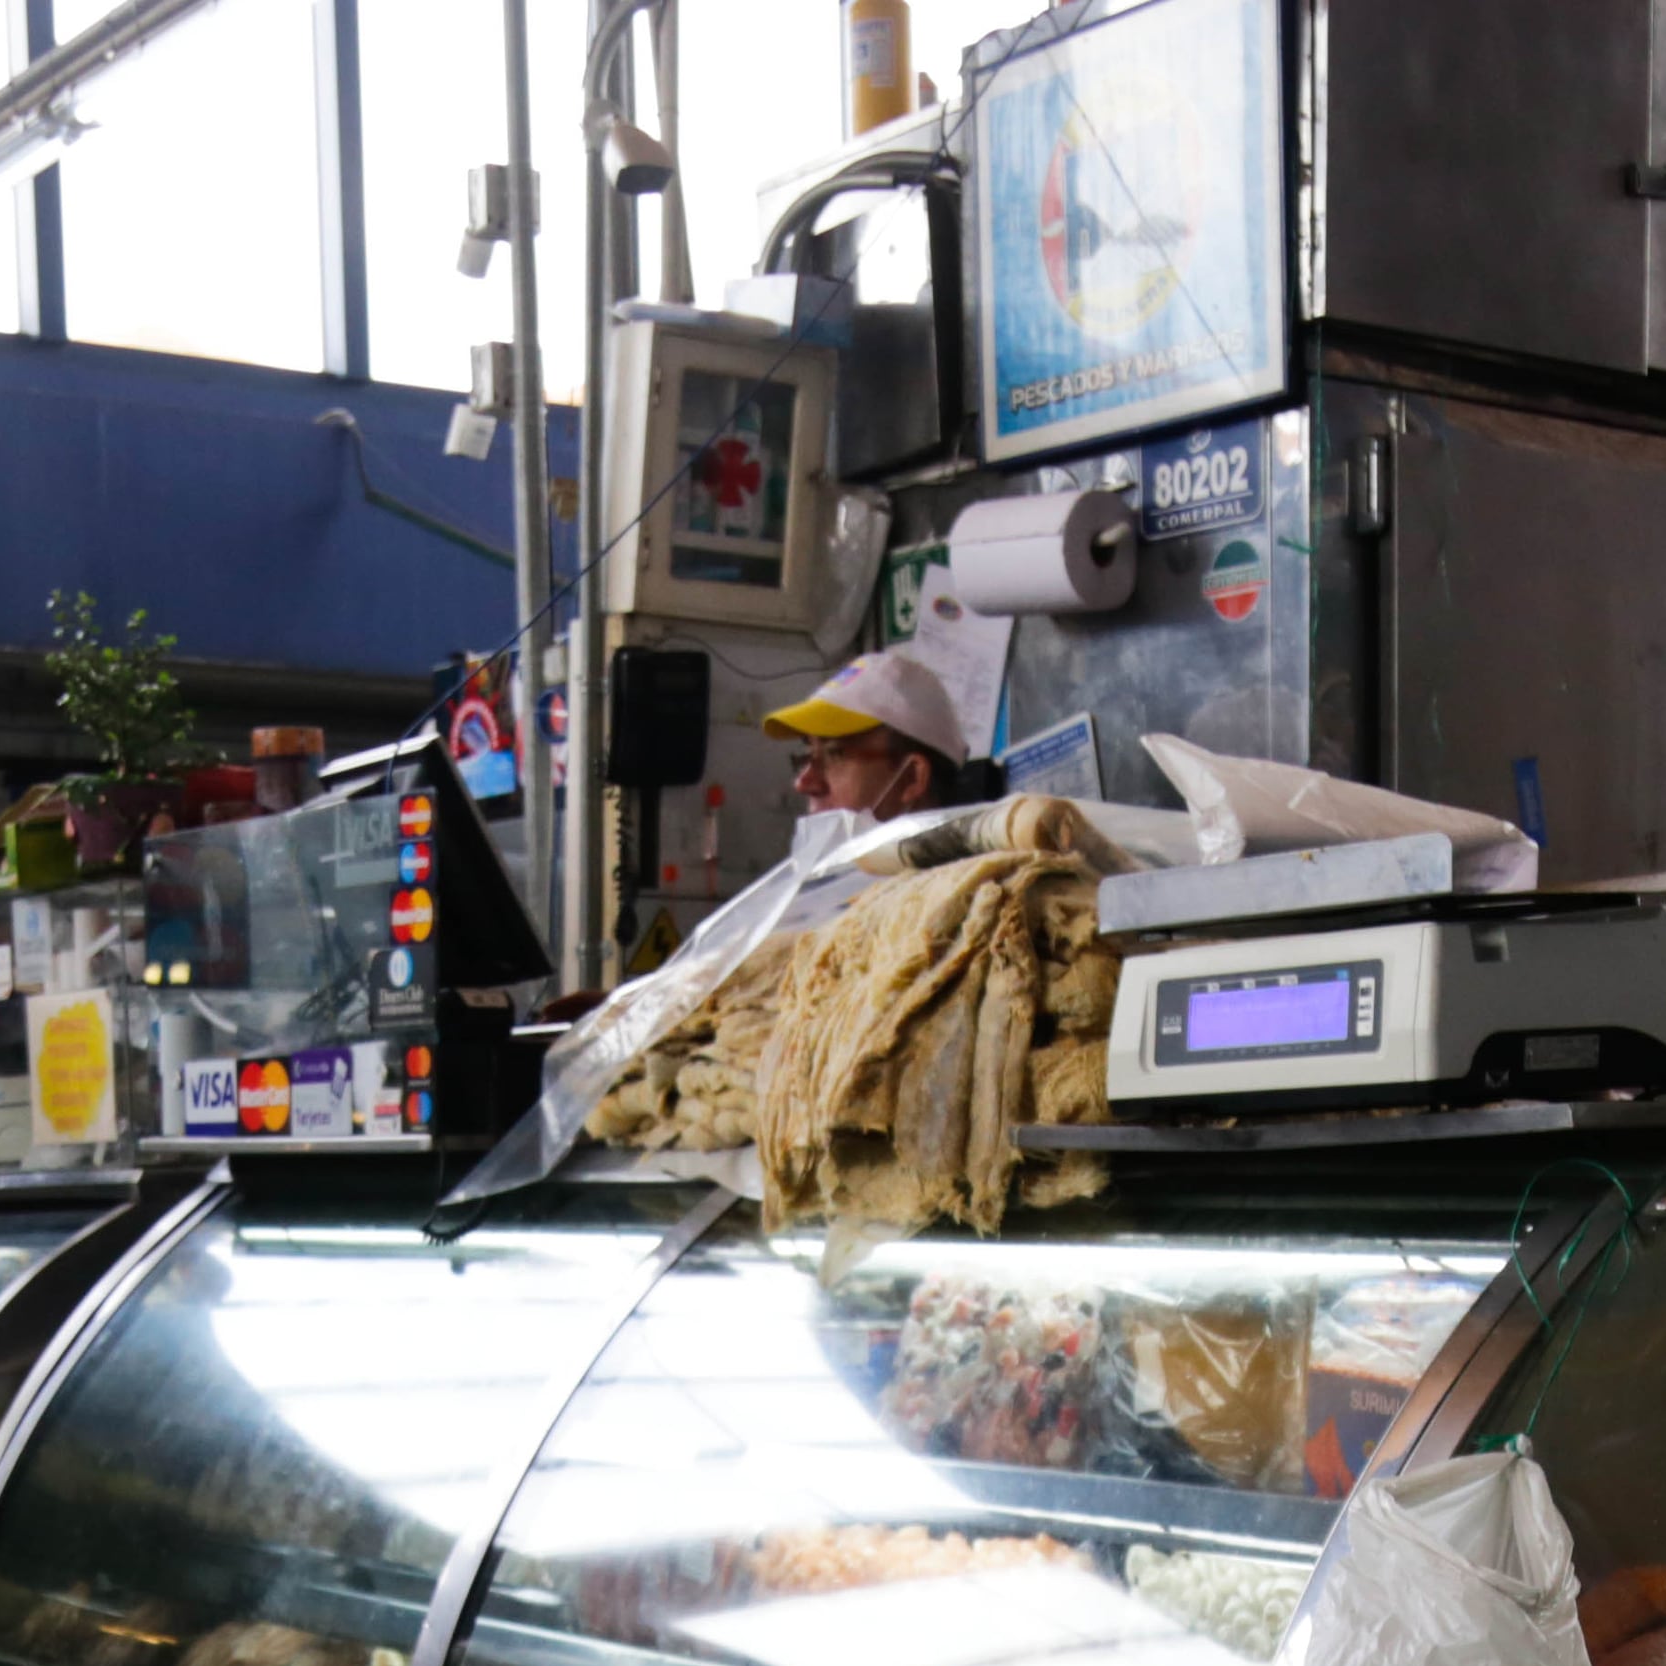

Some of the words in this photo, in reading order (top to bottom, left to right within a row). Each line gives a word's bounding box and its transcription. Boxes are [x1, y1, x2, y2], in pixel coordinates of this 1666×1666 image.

[1010, 366, 1114, 413] PESCADOS
[1119, 359, 1134, 385] Y
[1135, 330, 1246, 378] MARISCOS
[1154, 446, 1249, 509] 80202
[1157, 501, 1245, 530] COMERPAL
[192, 1070, 236, 1108] VISA
